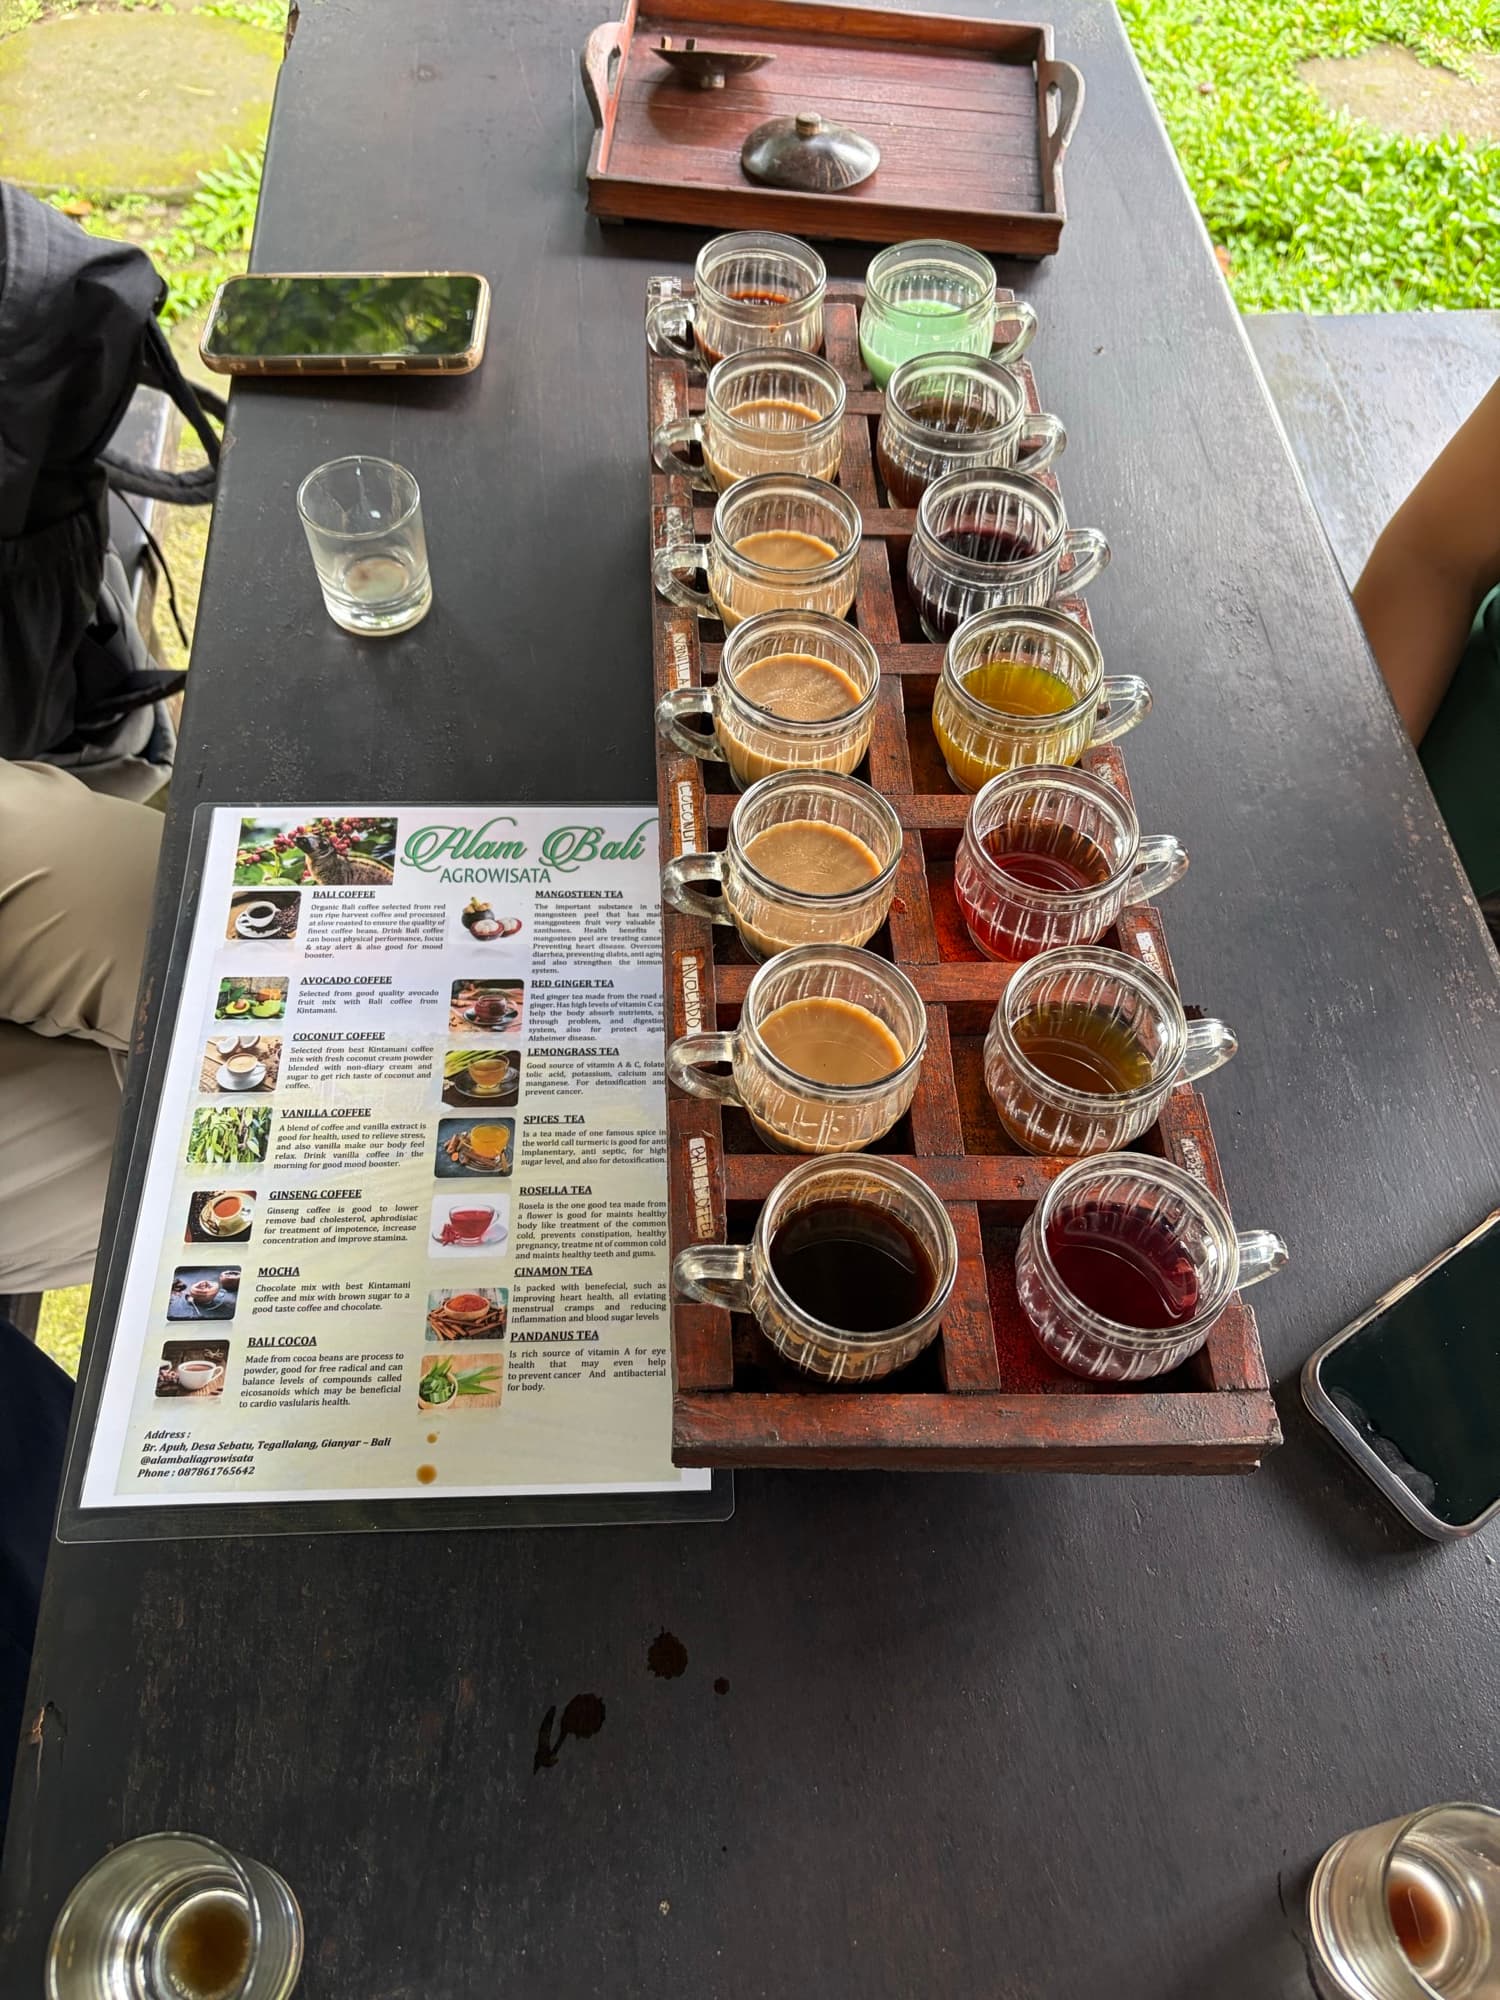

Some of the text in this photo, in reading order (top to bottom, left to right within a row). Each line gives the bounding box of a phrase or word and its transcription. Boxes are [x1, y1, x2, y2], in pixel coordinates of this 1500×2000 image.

[400, 817, 660, 872] Alam Bali
[440, 867, 552, 883] AGROWISATA
[312, 890, 375, 898] BALI COFFEE
[535, 890, 623, 898] MANGOSTEEN TEA
[300, 976, 392, 984] AVOCADO COFFEE
[530, 979, 614, 988] RED GINGER TEA
[355, 989, 375, 997] good
[378, 989, 404, 997] quality
[681, 964, 701, 1028] AVOCADO
[292, 1031, 385, 1041] COCONUT COFFEE
[527, 1047, 619, 1056] LEMONGRASS TEA
[403, 1054, 433, 1062] powder
[281, 1108, 371, 1117] VANILLA COFFEE
[523, 1114, 585, 1124] SPICES TEA
[273, 1162, 308, 1170] morning
[309, 1160, 321, 1168] for
[321, 1160, 342, 1169] good
[343, 1160, 367, 1168] mood
[544, 1157, 564, 1165] level,
[565, 1157, 581, 1165] and
[599, 1156, 611, 1164] for
[269, 1189, 362, 1199] GINSENG COFFEE
[519, 1185, 592, 1195] ROSELLA TEA
[517, 1221, 537, 1230] body
[541, 1221, 556, 1229] like
[603, 1220, 612, 1228] of
[615, 1219, 628, 1227] the
[320, 1235, 336, 1243] and
[337, 1235, 372, 1244] improve
[516, 1229, 666, 1240] cold, prevents constipation, healthy
[258, 1266, 299, 1276] MOCHA
[514, 1265, 592, 1277] CINAMON TEA
[255, 1284, 296, 1292] Chocolate
[321, 1282, 340, 1290] with
[345, 1282, 363, 1290] best
[368, 1281, 410, 1289] Kintamani
[513, 1284, 521, 1292] Is
[526, 1283, 555, 1293] packed
[560, 1283, 579, 1291] with
[633, 1281, 652, 1289] such
[251, 1304, 273, 1315] good
[296, 1303, 322, 1312] coffee
[323, 1303, 339, 1311] and
[340, 1302, 382, 1311] chocolate.
[512, 1302, 666, 1313] menstrual cramps and reducing
[247, 1336, 316, 1347] BALI COCOA
[510, 1330, 599, 1342] PANDANUS TEA
[508, 1360, 535, 1369] health
[549, 1359, 566, 1368] that
[581, 1360, 599, 1368] may
[647, 1357, 666, 1367] help
[243, 1365, 278, 1376] powder,
[280, 1365, 302, 1375] good
[304, 1364, 317, 1373] for
[318, 1364, 336, 1373] free
[338, 1363, 367, 1372] radical
[369, 1363, 386, 1371] and
[242, 1373, 402, 1385] balance levels of compounds called
[240, 1384, 401, 1396] eicosanoids which may be beneficial
[507, 1382, 544, 1392] for body.
[144, 1430, 185, 1439] Address
[141, 1443, 157, 1452] Br.
[158, 1442, 188, 1453] Apuh,
[190, 1442, 216, 1451] Desa
[217, 1441, 254, 1450] Sebatu,
[258, 1439, 318, 1451] Tegallalang,
[321, 1439, 361, 1449] Gianyar
[370, 1437, 391, 1446] Bali
[140, 1454, 253, 1465] @alambaliagrowisata
[137, 1468, 170, 1477] Phone
[177, 1466, 255, 1476] 087861765642
